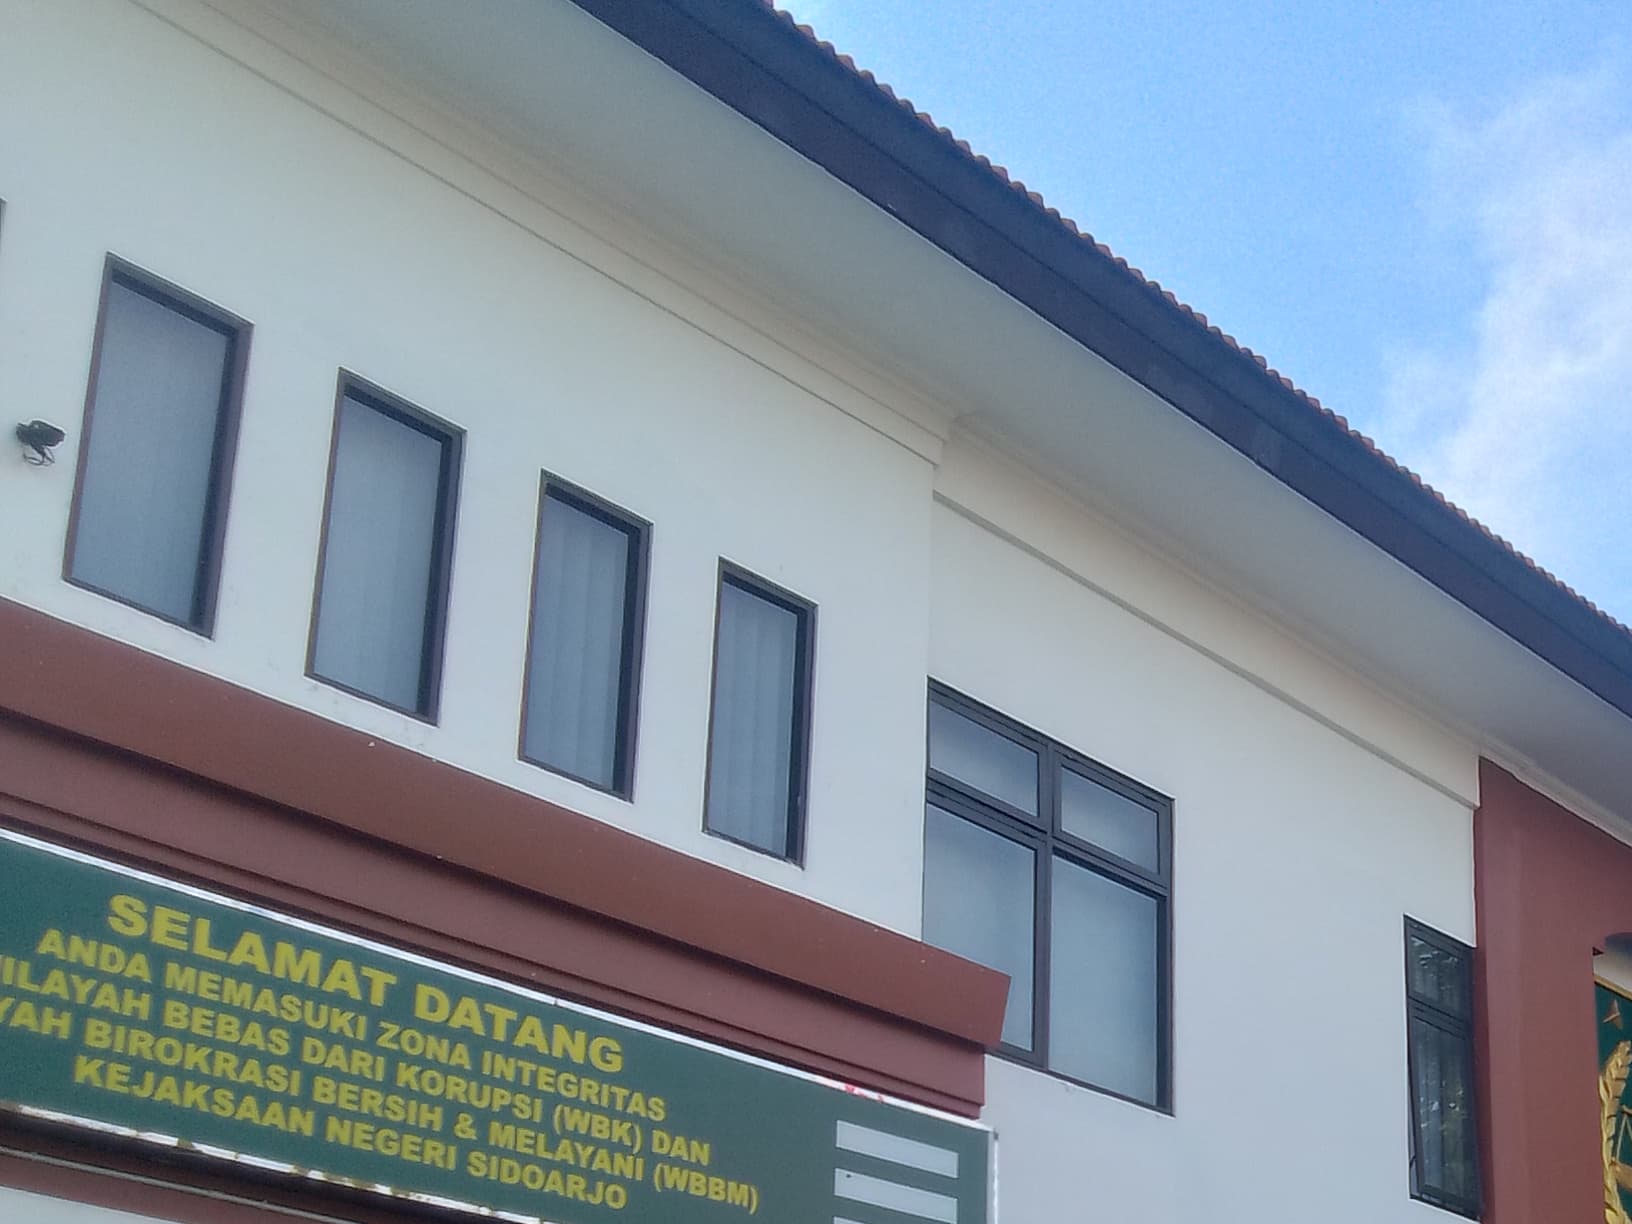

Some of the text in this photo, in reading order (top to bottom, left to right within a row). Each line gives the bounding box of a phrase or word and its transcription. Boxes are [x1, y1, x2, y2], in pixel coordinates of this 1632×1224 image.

[0, 954, 711, 1167] ILAYAH BEBAS DARI KORUPSI (WBK) DAN
[36, 929, 667, 1122] ANDA MEMASUKI ZONA INTEGRITAS
[107, 894, 625, 1073] SELAMAT DATANG
[73, 1055, 628, 1210] KEJAKSAAN NEGERI SIDOARJO
[84, 1018, 300, 1096] BIROKRASI
[312, 1075, 444, 1132] BERSIH
[453, 1112, 478, 1141] &
[488, 1120, 645, 1181] MELAYANI
[653, 1162, 760, 1215] (WBBM)
